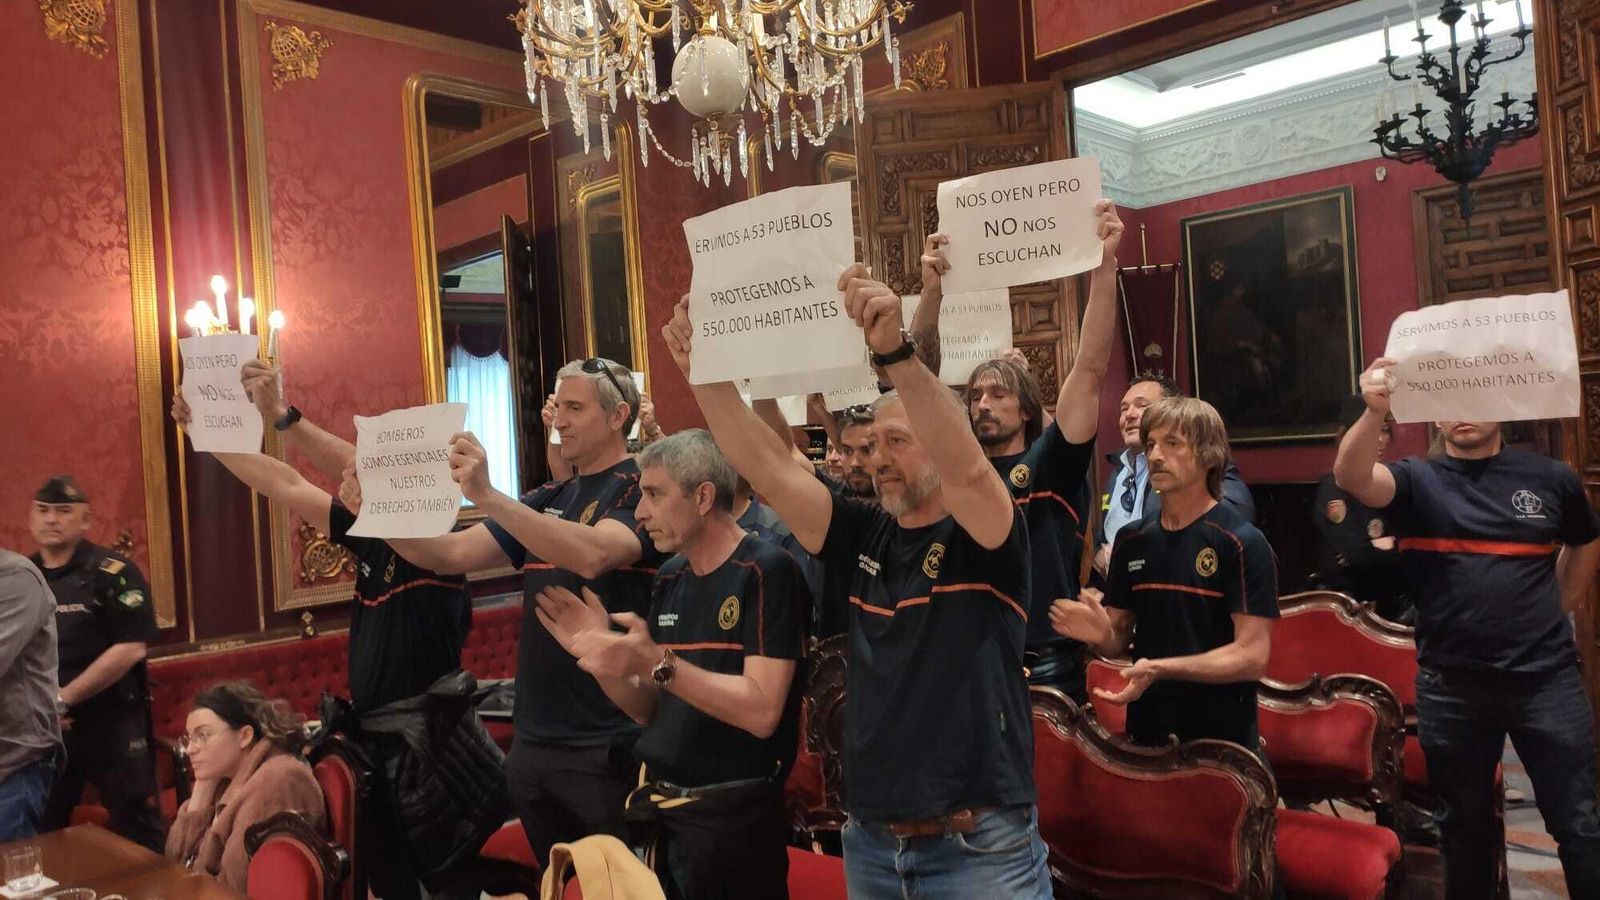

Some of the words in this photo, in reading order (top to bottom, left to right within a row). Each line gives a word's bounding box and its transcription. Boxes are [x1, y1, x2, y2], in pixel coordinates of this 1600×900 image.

[956, 192, 987, 209] NOS
[991, 185, 1033, 204] OYEN
[1039, 178, 1080, 197] PERO
[694, 229, 741, 253] ERVIMOS
[743, 227, 751, 242] A
[751, 223, 765, 239] 53
[768, 212, 833, 235] PUEBLOS
[984, 217, 1018, 238] NO
[1023, 217, 1056, 233] NOS
[978, 243, 1061, 266] ESCUCHAN
[710, 276, 801, 307] PROTEGEMOS
[803, 274, 815, 290] A
[703, 315, 752, 337] 550.000
[755, 301, 838, 329] HABITANTES
[1396, 318, 1458, 339] SERVIMOS
[1461, 316, 1471, 328] A
[1475, 315, 1490, 328] 53
[1496, 310, 1557, 324] PUEBLOS
[215, 353, 238, 368] PERO
[1418, 352, 1519, 372] PROTEGEMOS
[1523, 351, 1536, 363] A
[1407, 378, 1459, 392] 550.000
[1462, 371, 1555, 389] HABITANTES
[198, 384, 218, 401] NO
[203, 415, 243, 429] ESCUCHAN
[376, 426, 425, 444] BOMBEROS
[361, 455, 395, 470] SOMOS
[396, 448, 449, 466] ESENCIALES
[390, 474, 436, 489] NUESTROS
[370, 500, 415, 515] DERECHOS
[416, 495, 455, 512] TAMBIÉN
